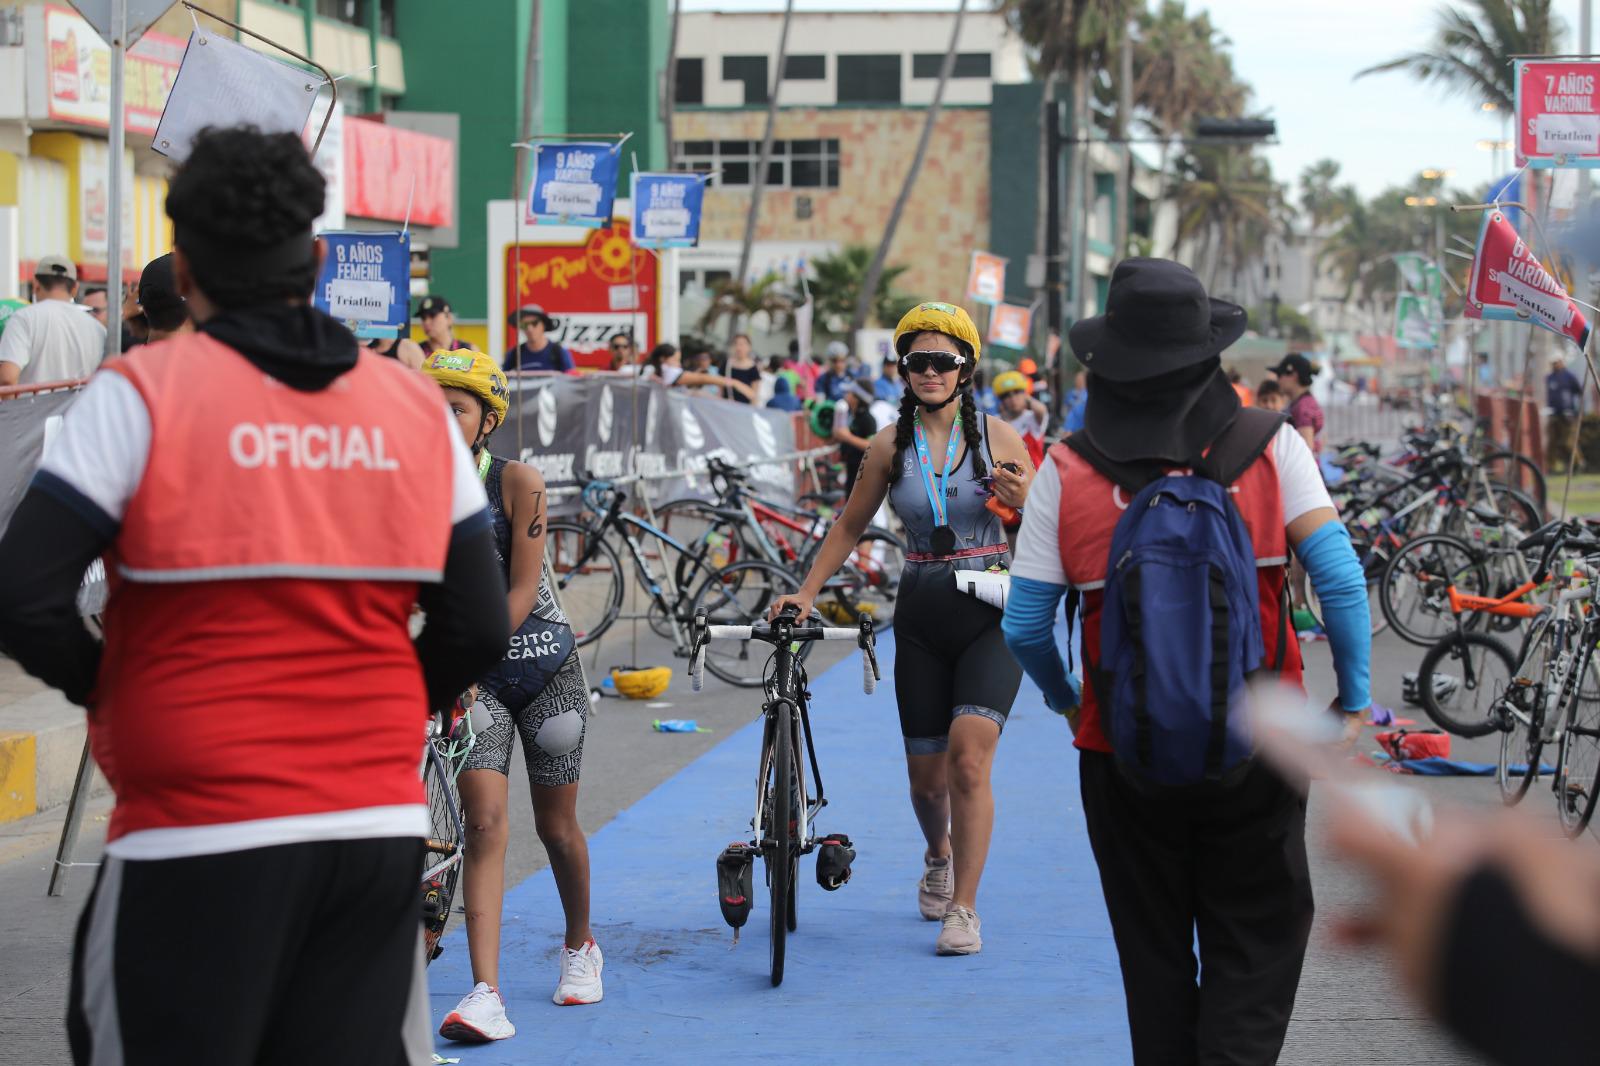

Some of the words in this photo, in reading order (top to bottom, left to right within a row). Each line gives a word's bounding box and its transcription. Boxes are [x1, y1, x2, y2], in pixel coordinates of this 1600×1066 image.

[1545, 75, 1555, 95] 7
[1558, 72, 1595, 95] AÑOS
[1544, 95, 1595, 113] VARONIL
[336, 244, 346, 263] 8
[349, 242, 383, 263] AÑOS
[337, 263, 384, 281] FEMENIL
[228, 421, 399, 471] OFICIAL
[508, 630, 553, 647] CITO
[502, 642, 560, 661] CANO
